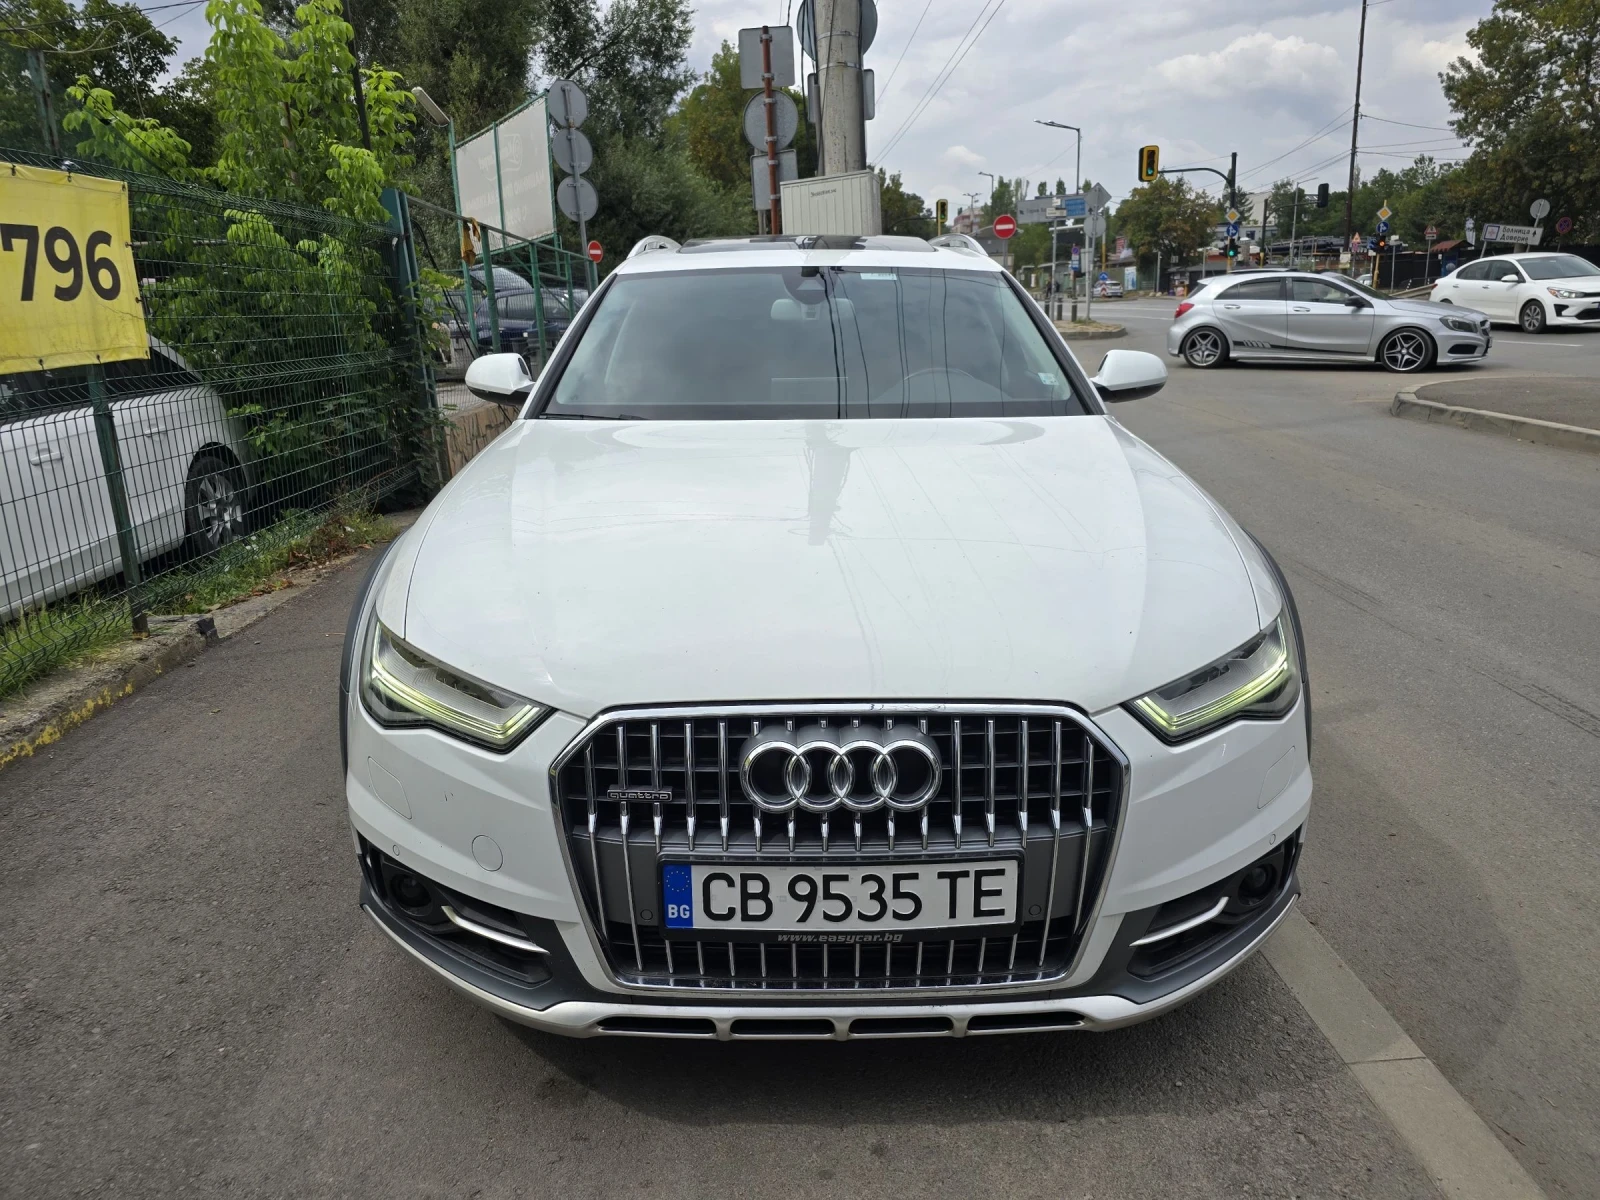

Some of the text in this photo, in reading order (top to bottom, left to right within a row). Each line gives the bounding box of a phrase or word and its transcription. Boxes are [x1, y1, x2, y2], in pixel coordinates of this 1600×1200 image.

[1502, 226, 1531, 235] Болница
[1500, 234, 1529, 242] Доверие
[0, 223, 121, 301] 796
[609, 792, 669, 800] quattro
[702, 868, 1006, 923] CB 9535 TE
[667, 904, 691, 919] BG
[777, 932, 903, 944] www.easycar.bg
